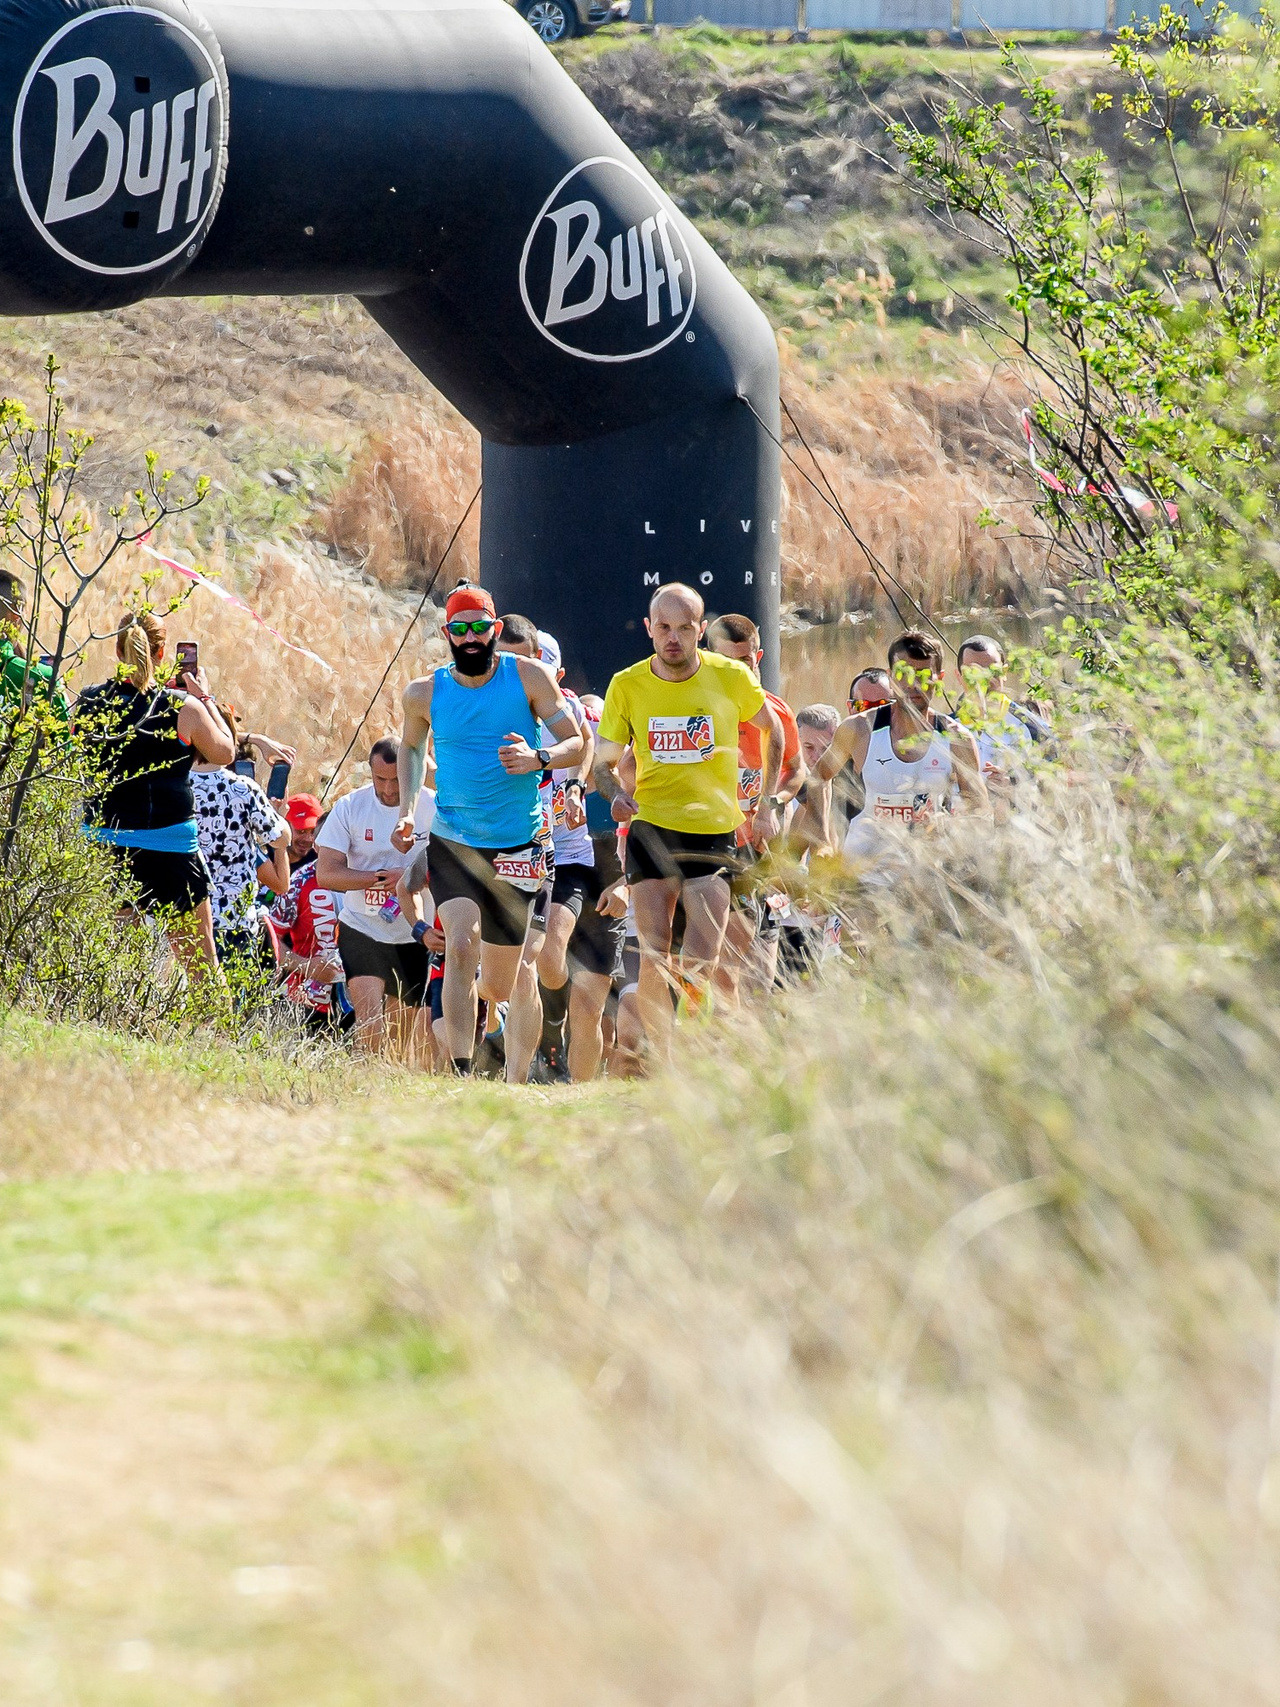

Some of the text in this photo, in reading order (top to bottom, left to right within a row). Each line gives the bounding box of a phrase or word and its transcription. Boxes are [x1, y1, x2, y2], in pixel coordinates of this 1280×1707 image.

[644, 519, 777, 534] LIVE
[643, 570, 777, 586] MORE
[653, 732, 683, 750] 2121
[496, 862, 531, 877] 2359
[308, 888, 337, 954] KOVO
